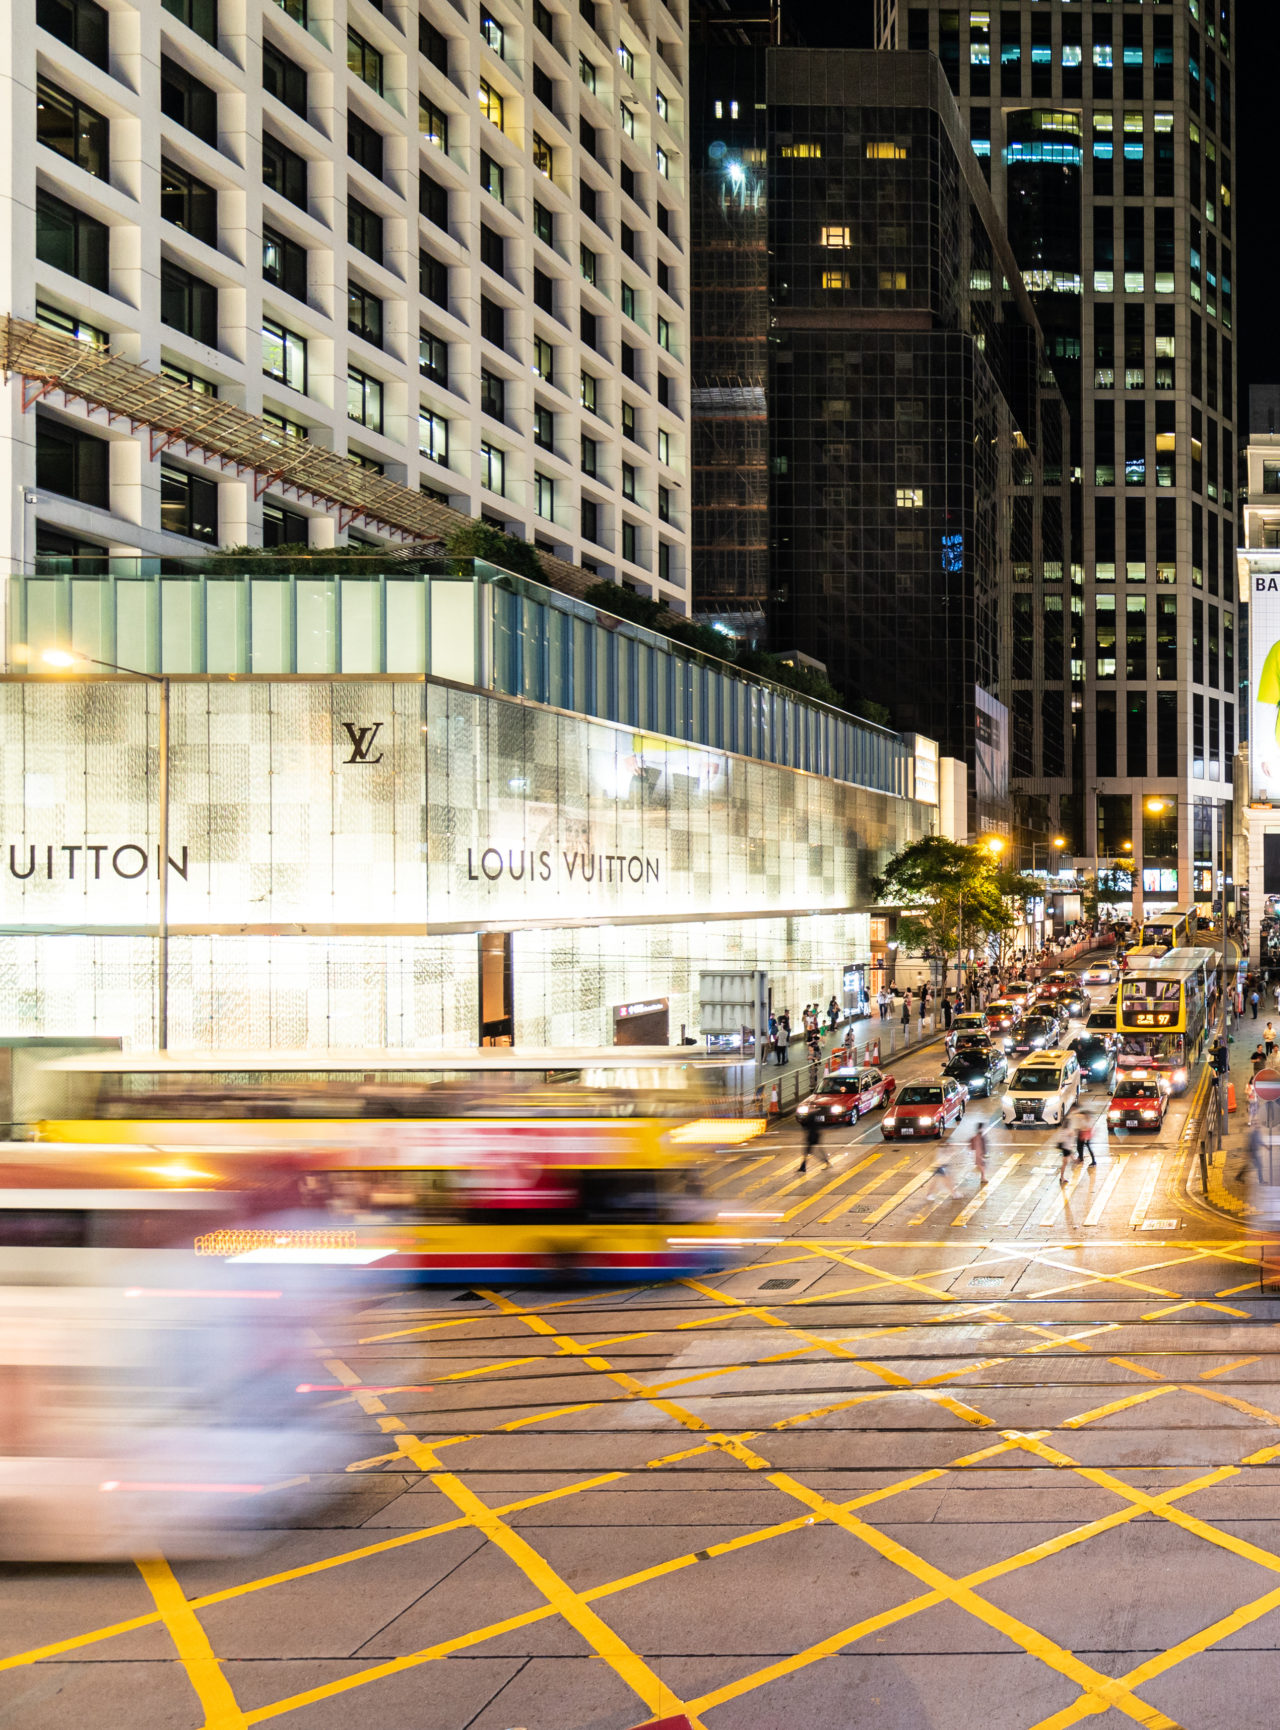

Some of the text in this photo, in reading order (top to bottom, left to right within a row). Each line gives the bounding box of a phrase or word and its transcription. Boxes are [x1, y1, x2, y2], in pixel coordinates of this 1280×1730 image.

[0, 844, 188, 881] UITTON
[467, 847, 660, 883] LOUIS VUITTON
[1158, 1014, 1170, 1024] 97
